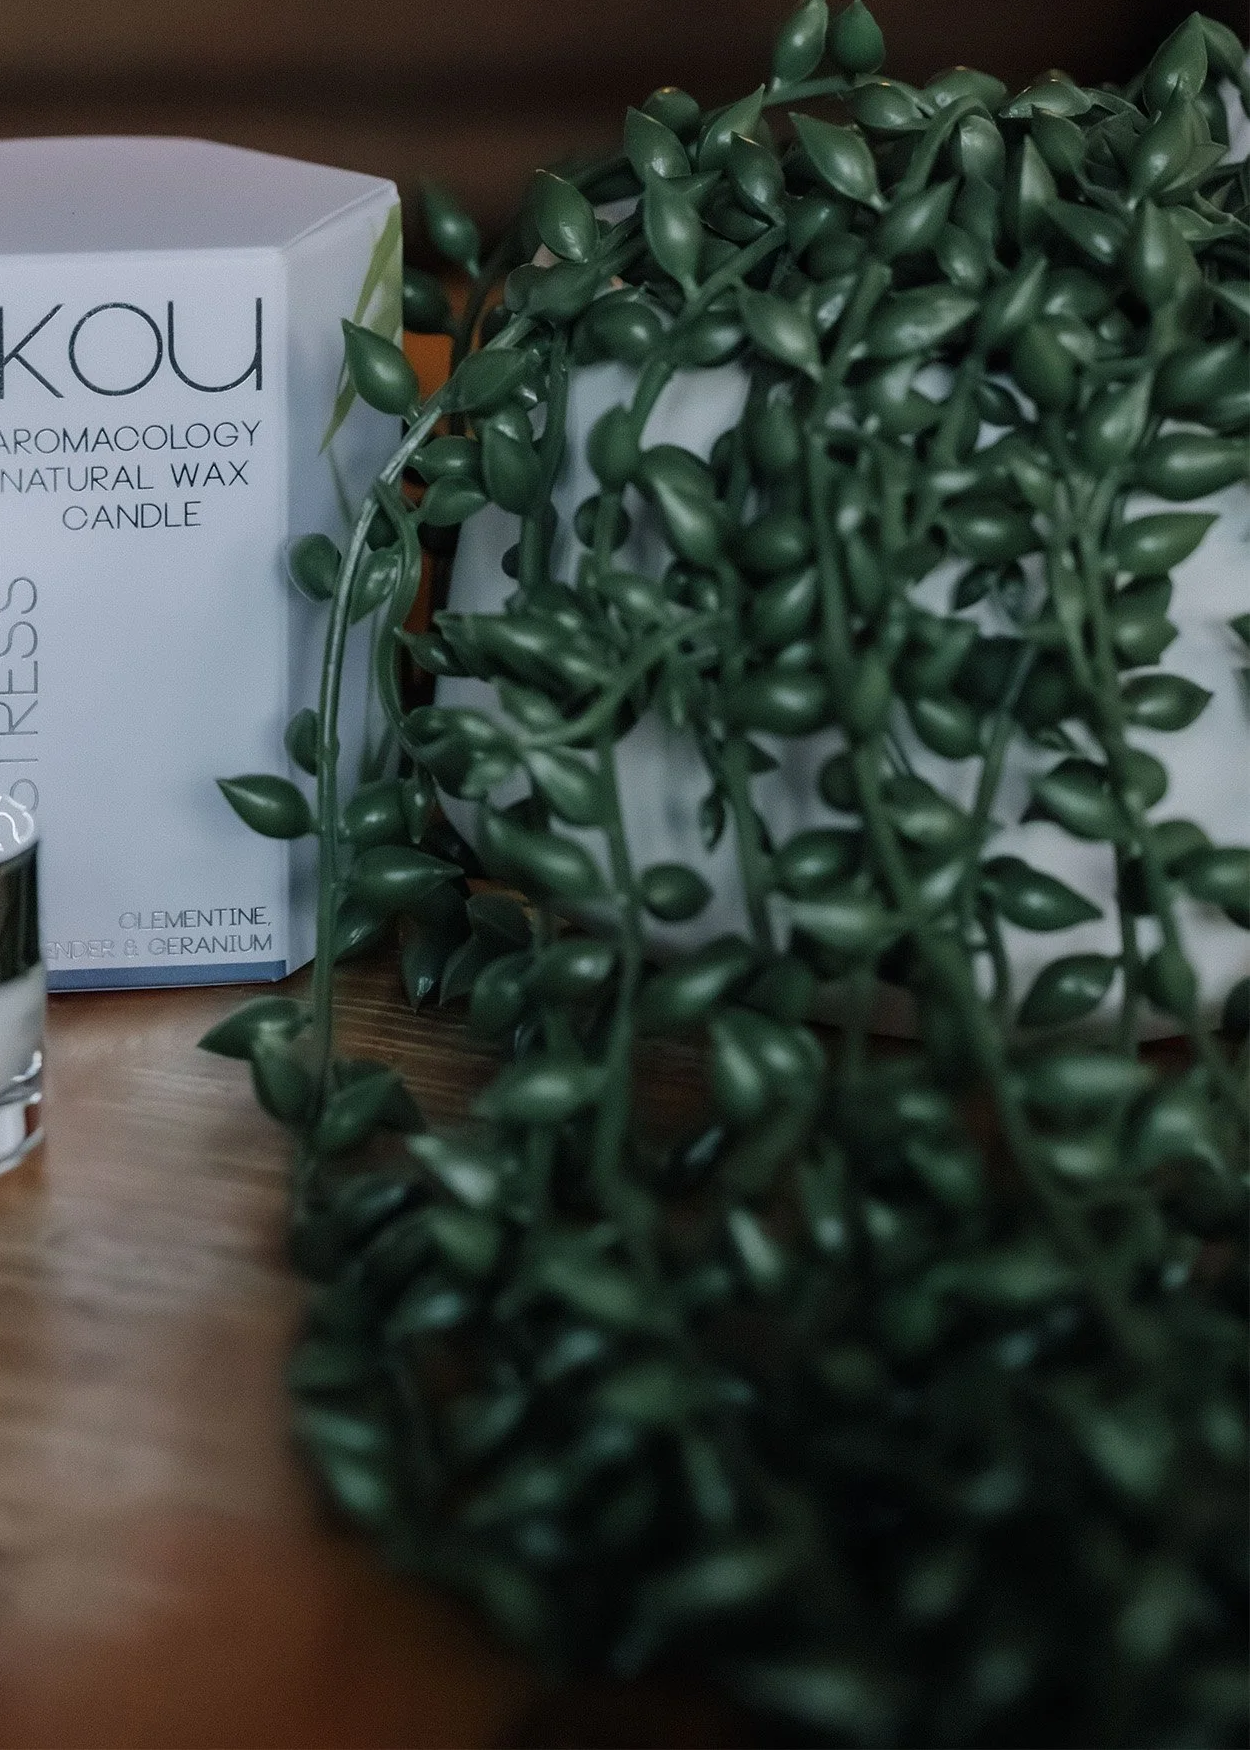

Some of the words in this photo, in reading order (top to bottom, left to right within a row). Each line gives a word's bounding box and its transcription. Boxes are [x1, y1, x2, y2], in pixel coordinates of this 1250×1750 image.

[0, 465, 154, 493] NATURAL
[170, 460, 249, 489] WAX
[62, 500, 202, 531] CANDLE
[119, 906, 272, 930] CLEMENTINE,
[148, 933, 272, 956] GERANIUM
